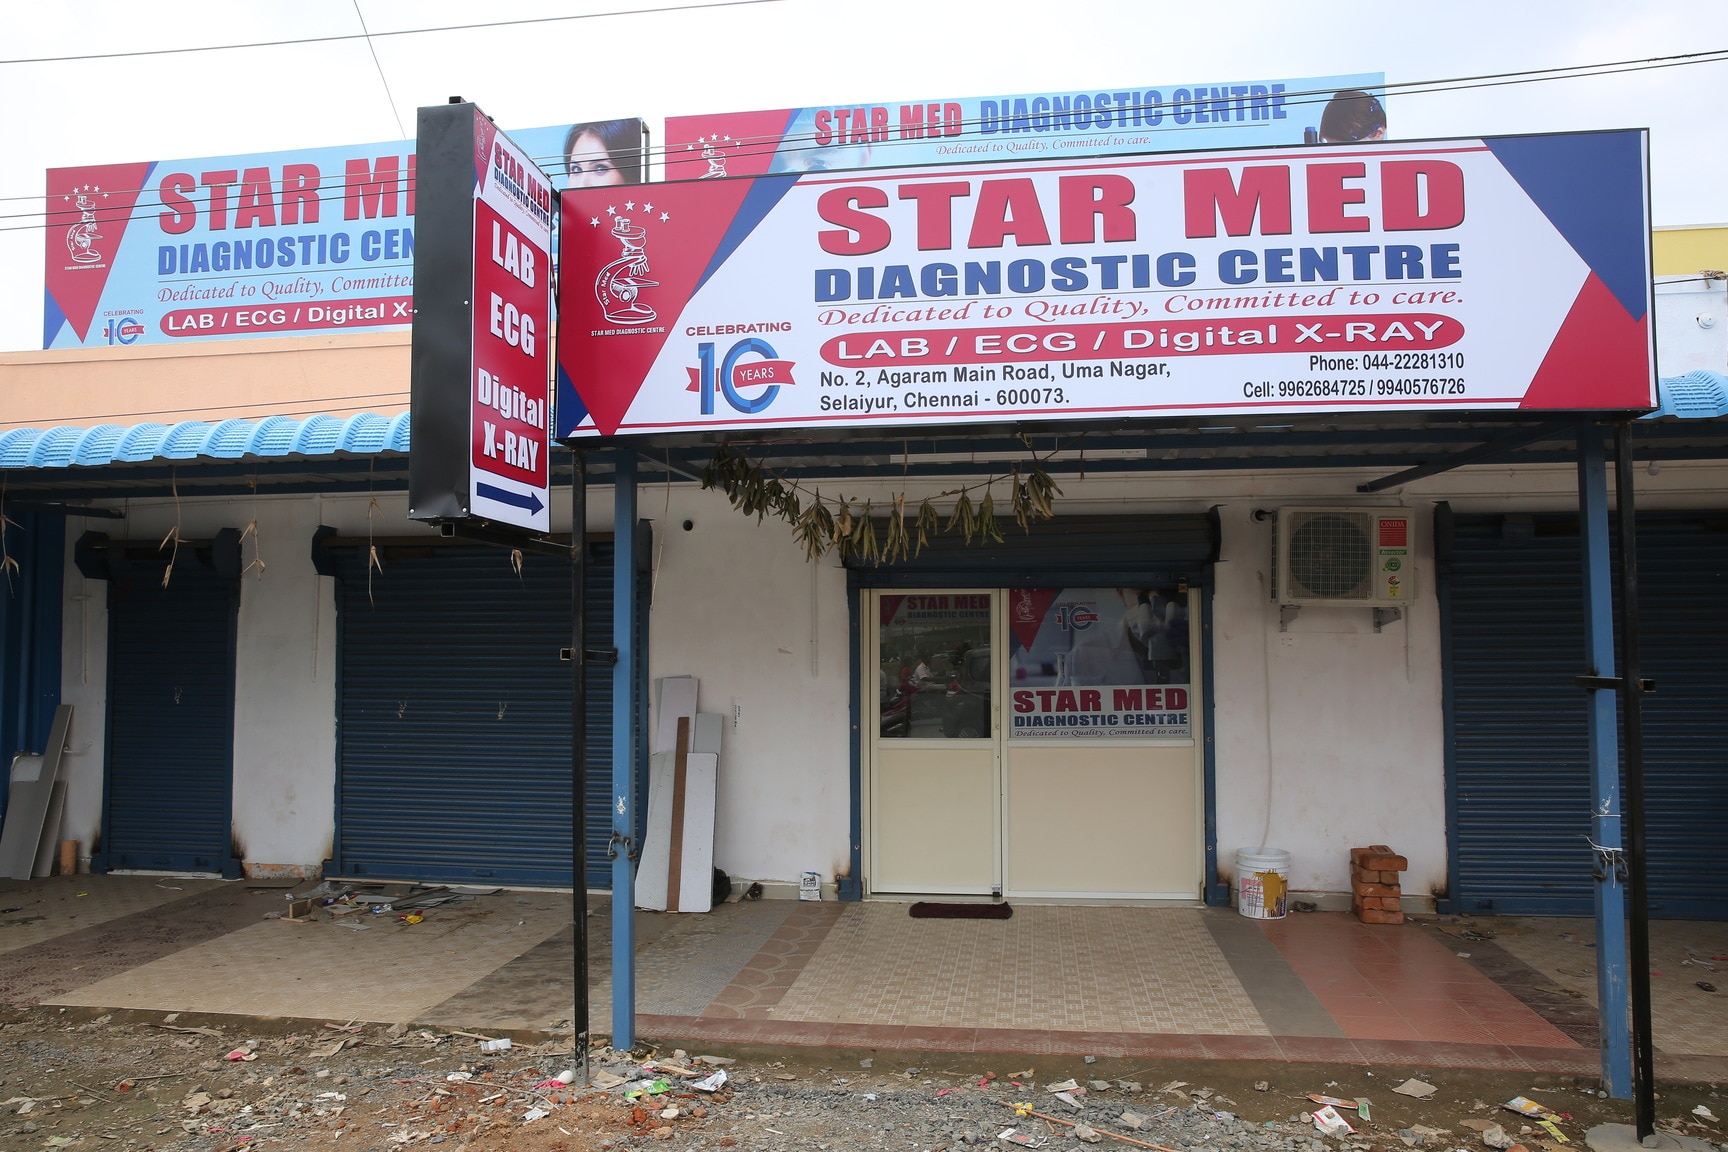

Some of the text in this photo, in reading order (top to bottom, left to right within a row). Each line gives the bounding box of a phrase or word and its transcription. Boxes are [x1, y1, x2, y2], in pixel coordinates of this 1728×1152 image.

[814, 84, 1287, 145] STAR MED DIAGNOSTIC CENTRE
[936, 136, 1151, 155] Dedicated to Quality, Committed to care.
[494, 142, 525, 190] STAR
[527, 172, 550, 213] MED
[159, 163, 321, 235] STAR
[817, 159, 1465, 256] STAR MED
[158, 232, 350, 275] DIAGNOSTIC
[492, 220, 535, 289] LAB
[814, 243, 1462, 302] DIAGNOSTIC CENTRE
[157, 281, 239, 302] Dedicated
[241, 284, 255, 297] to
[261, 277, 324, 300] Quality,
[103, 309, 144, 317] CELEBRATING
[168, 314, 214, 330] LAB
[220, 313, 229, 327] /
[236, 310, 285, 326] ECG
[293, 308, 301, 324] /
[308, 303, 385, 327] Digital
[817, 287, 1463, 326] Dedicated to Quality, Committed to care.
[490, 291, 535, 358] ECG
[686, 322, 792, 336] CELEBRATING
[838, 320, 1444, 360] LAB / ECG / Digital X-RAY
[698, 337, 780, 415] 10
[740, 367, 774, 381] YEARS
[820, 360, 1171, 388] No. 2, Agaram Main Road, Uma Nagar,
[1309, 353, 1464, 371] Phone: 044-22281310
[478, 367, 544, 431] Digital
[820, 395, 897, 413] Selaiyur,
[904, 391, 979, 409] Chennai
[996, 388, 1070, 407] 600073.
[1243, 382, 1274, 398] Cell:
[1278, 380, 1366, 397] 9962684725
[1377, 378, 1465, 395] 9940576726
[483, 420, 539, 473] X-RAY
[907, 594, 990, 610] STAR MED
[1013, 688, 1188, 713] STAR MED
[1014, 713, 1188, 727] DIAGNOSTIC CENTRE
[1071, 728, 1105, 738] Quality,
[1109, 728, 1157, 736] Committed
